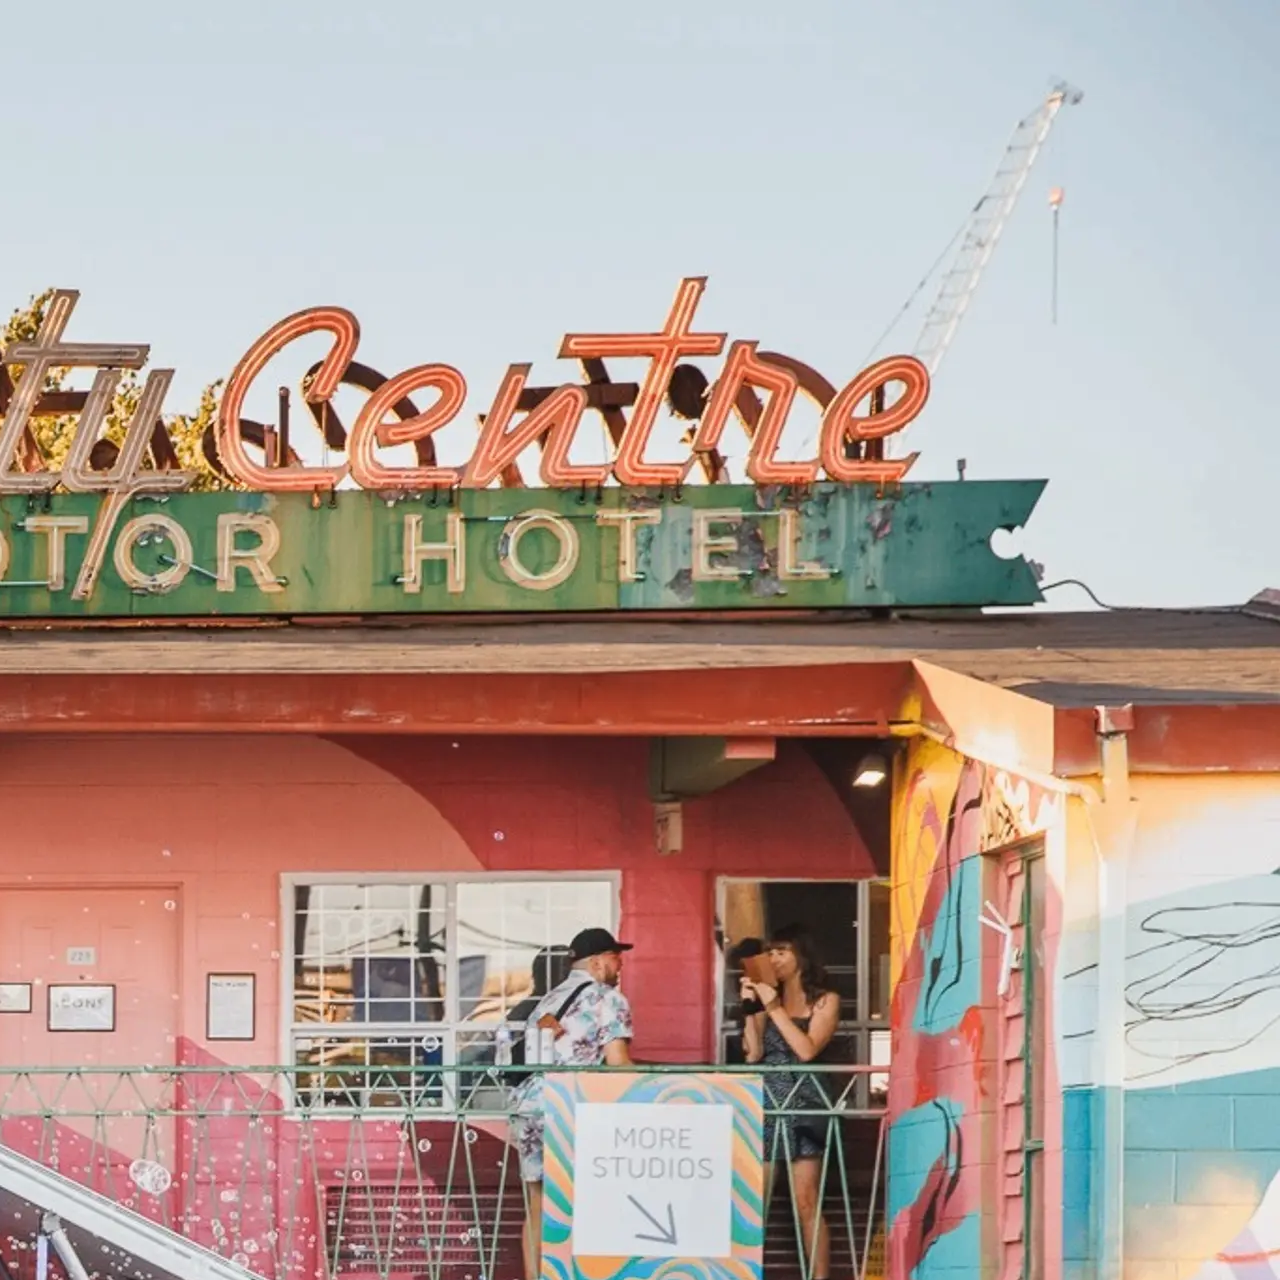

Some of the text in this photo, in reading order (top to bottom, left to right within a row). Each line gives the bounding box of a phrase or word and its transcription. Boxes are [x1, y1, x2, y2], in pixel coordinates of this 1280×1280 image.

[215, 275, 931, 491] Centre
[402, 507, 840, 593] HOTEL
[614, 1127, 693, 1150] MORE
[592, 1156, 714, 1180] STUDIOS
